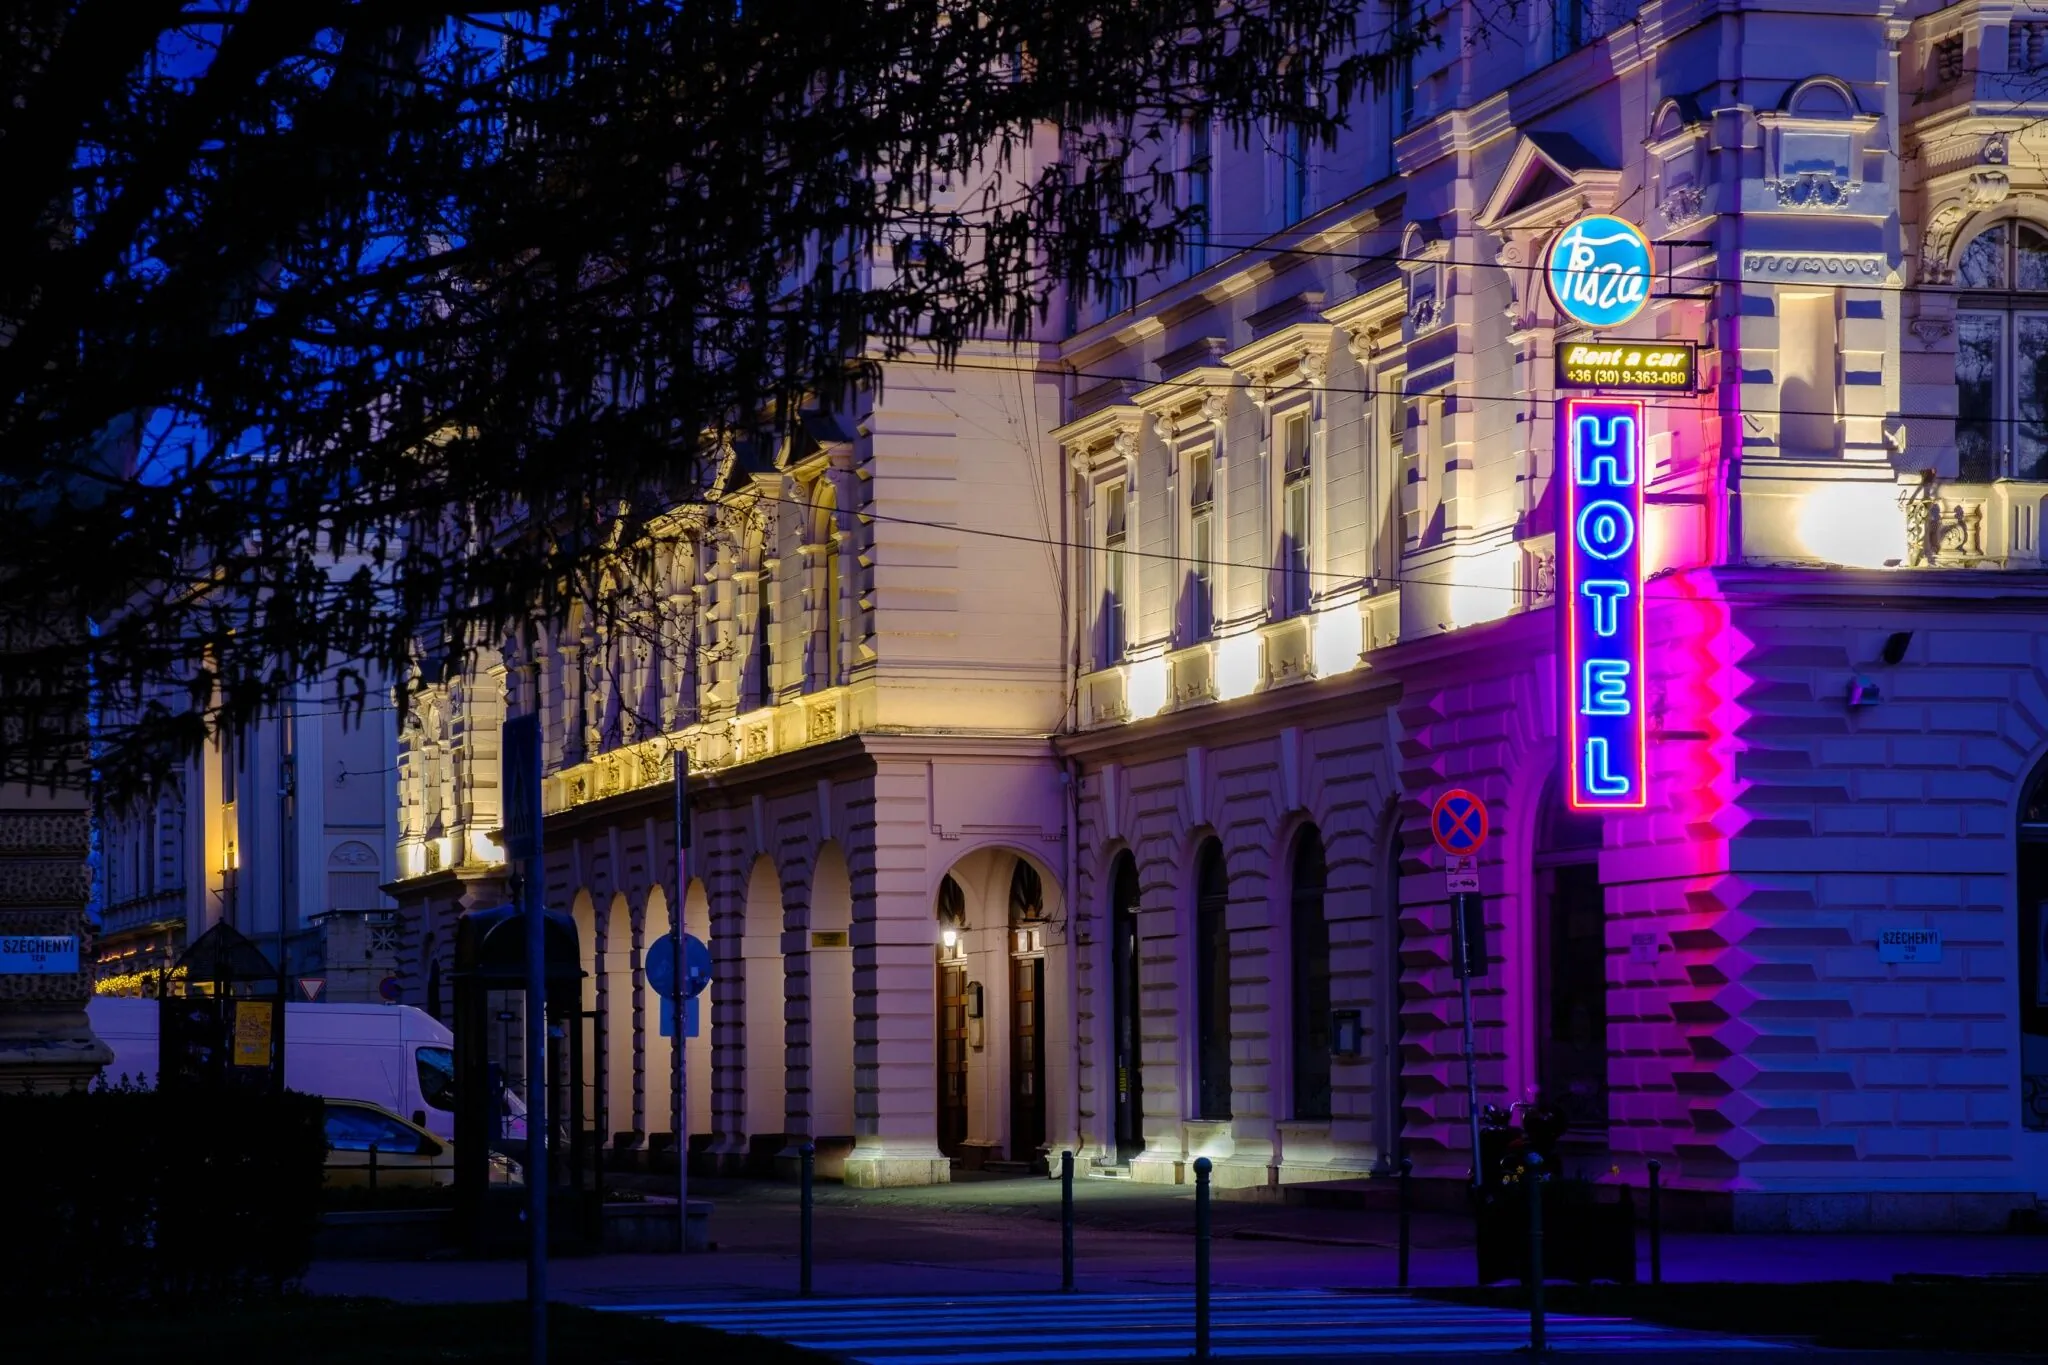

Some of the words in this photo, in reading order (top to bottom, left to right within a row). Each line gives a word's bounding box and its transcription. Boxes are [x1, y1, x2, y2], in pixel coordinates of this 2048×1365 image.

[1568, 346, 1622, 365] Rent
[1625, 352, 1641, 366] a
[1645, 352, 1685, 366] car
[1568, 369, 1591, 382] +36
[1595, 369, 1619, 385] (30)
[1622, 370, 1685, 384] 9-363-080
[1575, 416, 1635, 794] HOTEL
